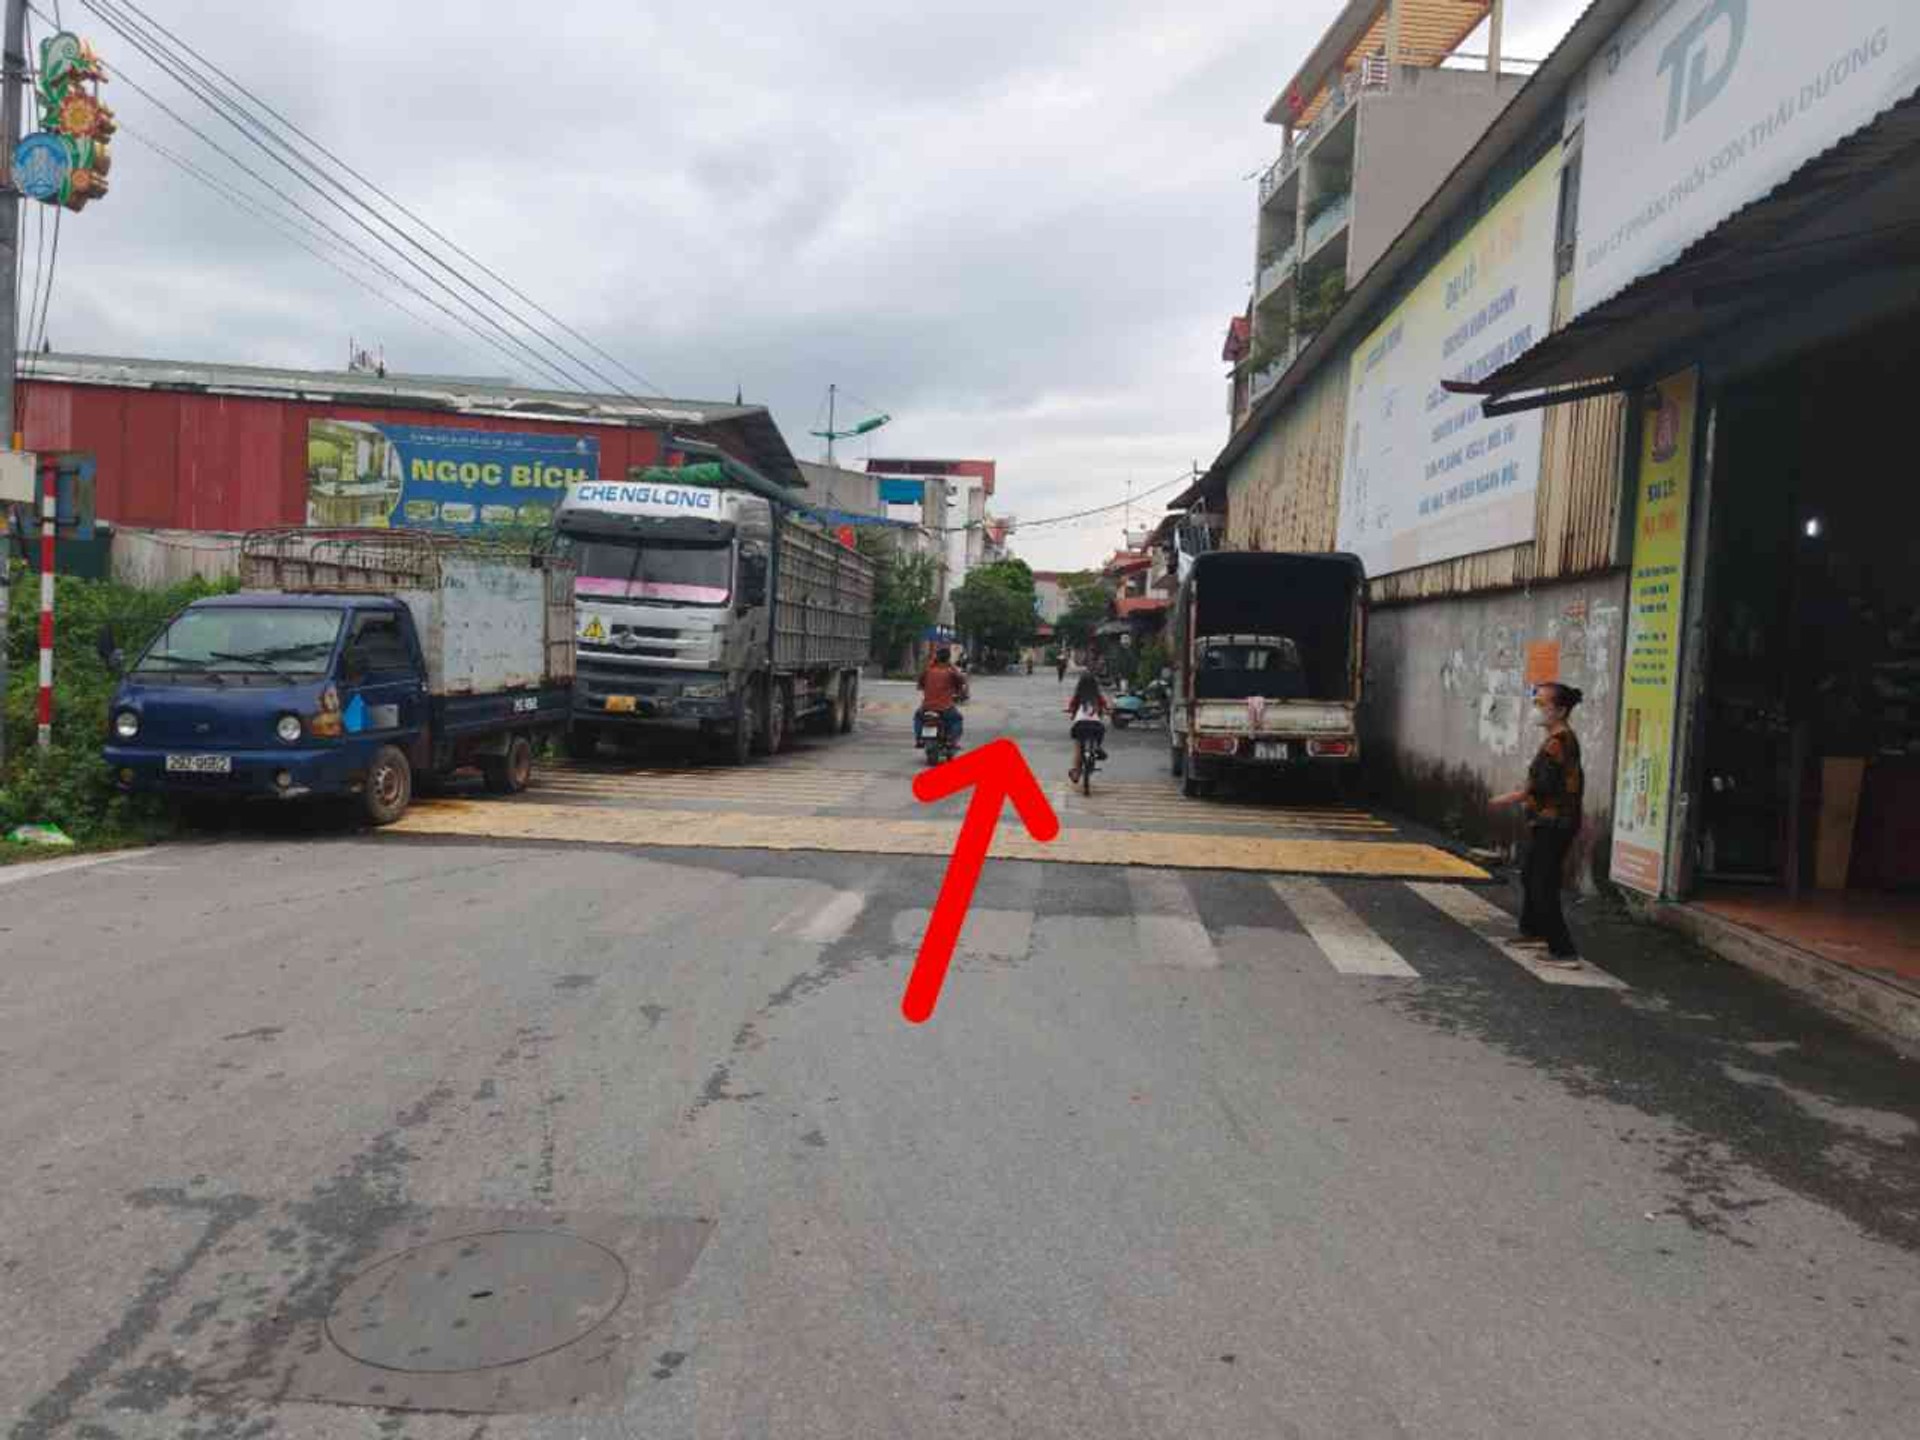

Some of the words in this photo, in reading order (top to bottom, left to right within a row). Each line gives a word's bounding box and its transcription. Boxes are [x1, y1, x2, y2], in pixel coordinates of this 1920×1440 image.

[1799, 25, 1889, 112] DƯƠNG
[411, 457, 502, 489] NGỌC
[510, 461, 588, 489] BÍCH
[577, 485, 711, 509] CHENGLONG
